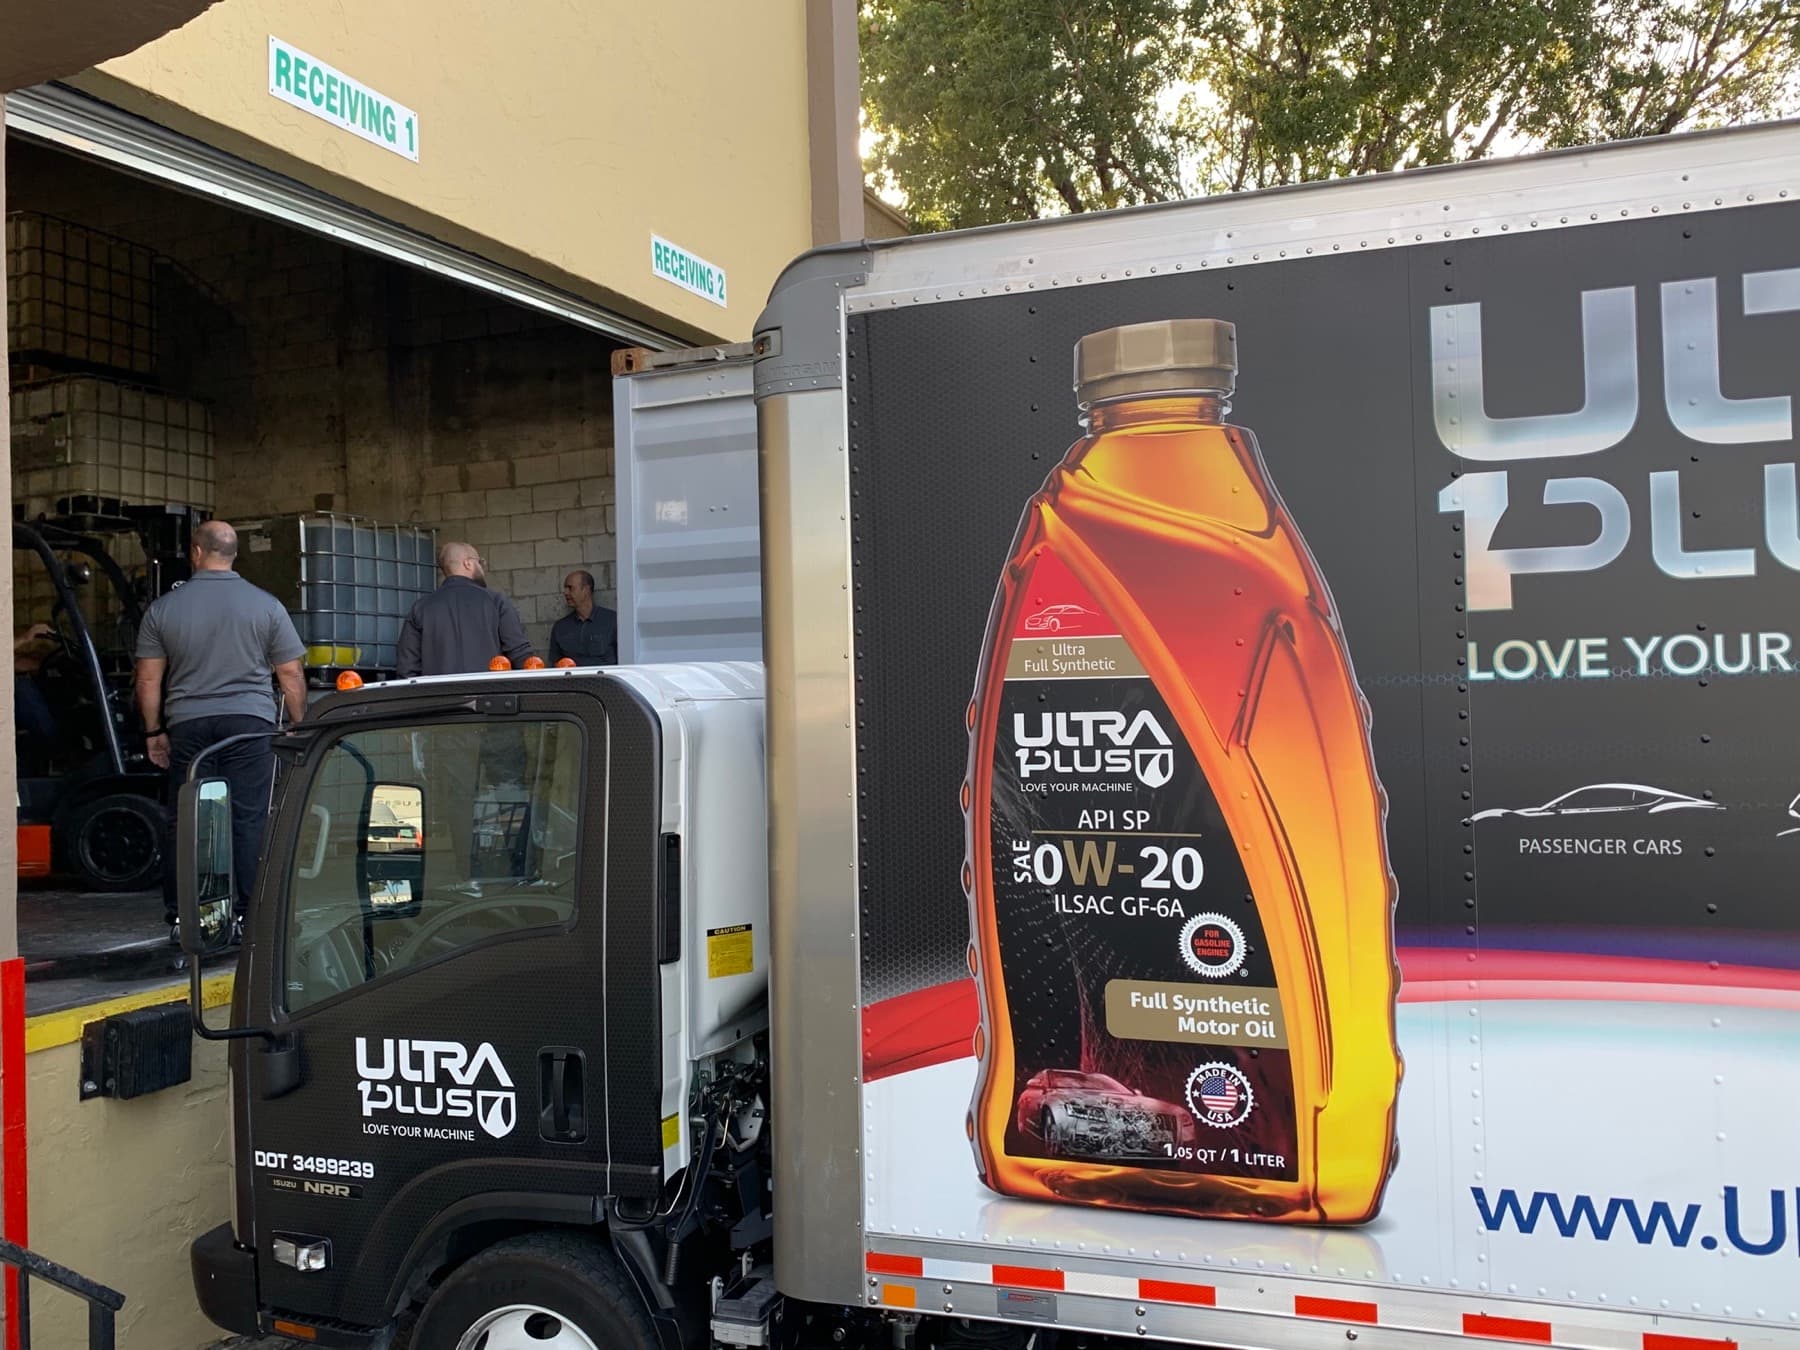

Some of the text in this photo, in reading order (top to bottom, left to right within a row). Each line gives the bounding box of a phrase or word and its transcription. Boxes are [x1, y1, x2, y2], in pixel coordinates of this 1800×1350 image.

[276, 48, 414, 152] RECEIVING 1
[654, 241, 725, 300] RECEIVING 2
[1052, 643, 1086, 657] Ultra
[1467, 632, 1793, 681] LOVE YOUR
[1024, 657, 1116, 674] Full Synthetic
[1013, 709, 1173, 747] ULTRA
[1020, 782, 1134, 793] LOVE YOUR MACHINE
[1078, 809, 1151, 831] API SP
[1519, 838, 1683, 856] PASSENGER CARS
[1012, 840, 1033, 884] SAE
[1033, 840, 1205, 891] 0W-20
[1054, 894, 1186, 919] ILSAC GF-6A
[714, 925, 746, 935] CAUTION
[1204, 929, 1220, 938] FOR
[1194, 939, 1231, 948] GASOLINE
[1197, 948, 1229, 957] ENGINES
[1194, 961, 1234, 973] CERTIFIED
[1130, 991, 1271, 1016] Full Synthetic
[1177, 1016, 1276, 1039] Motor Oil
[355, 1036, 515, 1088] ULTRA
[1196, 1068, 1241, 1087] MADE IN
[1207, 1110, 1234, 1123] USA
[362, 1123, 475, 1141] LOVE YOUR MACHINE
[255, 1150, 375, 1179] DOT 3499239
[1196, 1148, 1217, 1164] QT
[1230, 1149, 1240, 1163] 1
[1245, 1153, 1286, 1168] LITER
[273, 1179, 350, 1197] ISUZU NRR
